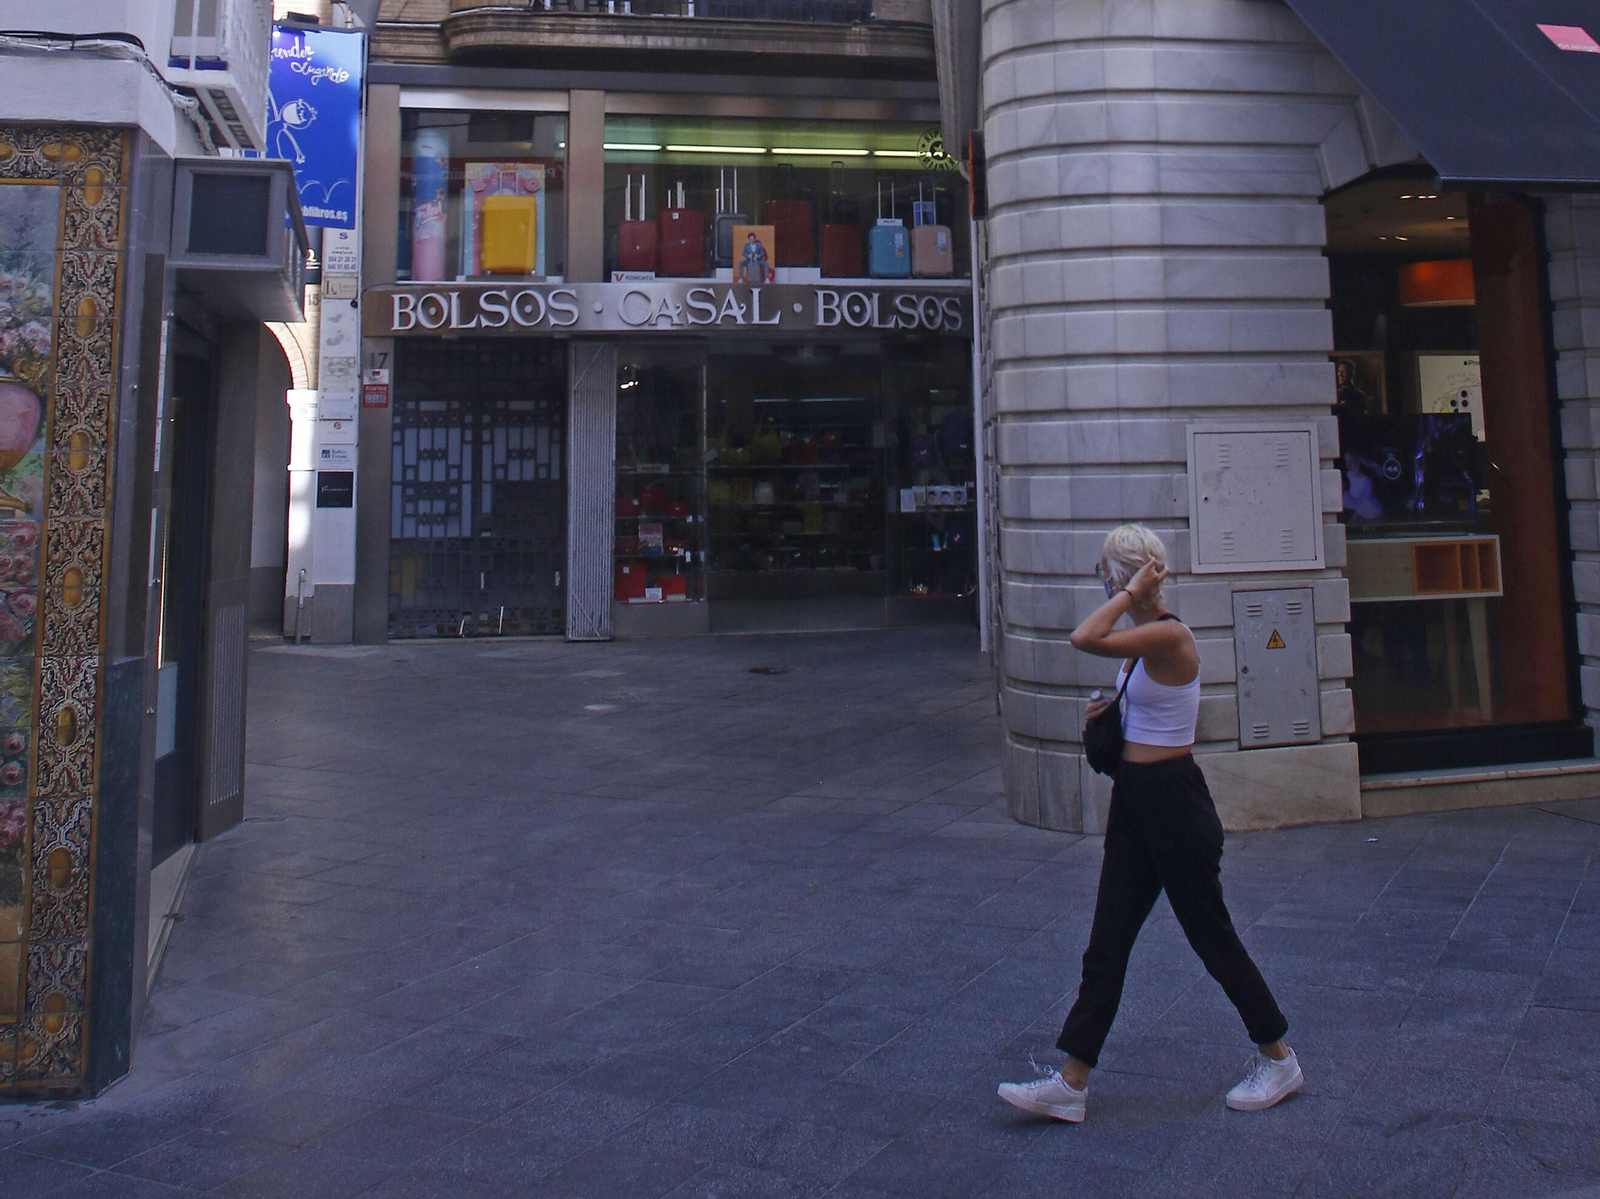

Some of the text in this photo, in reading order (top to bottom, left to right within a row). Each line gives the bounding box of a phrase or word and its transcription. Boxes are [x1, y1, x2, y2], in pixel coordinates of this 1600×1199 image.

[391, 288, 962, 331] BOLSOS CASAL BOLSOS
